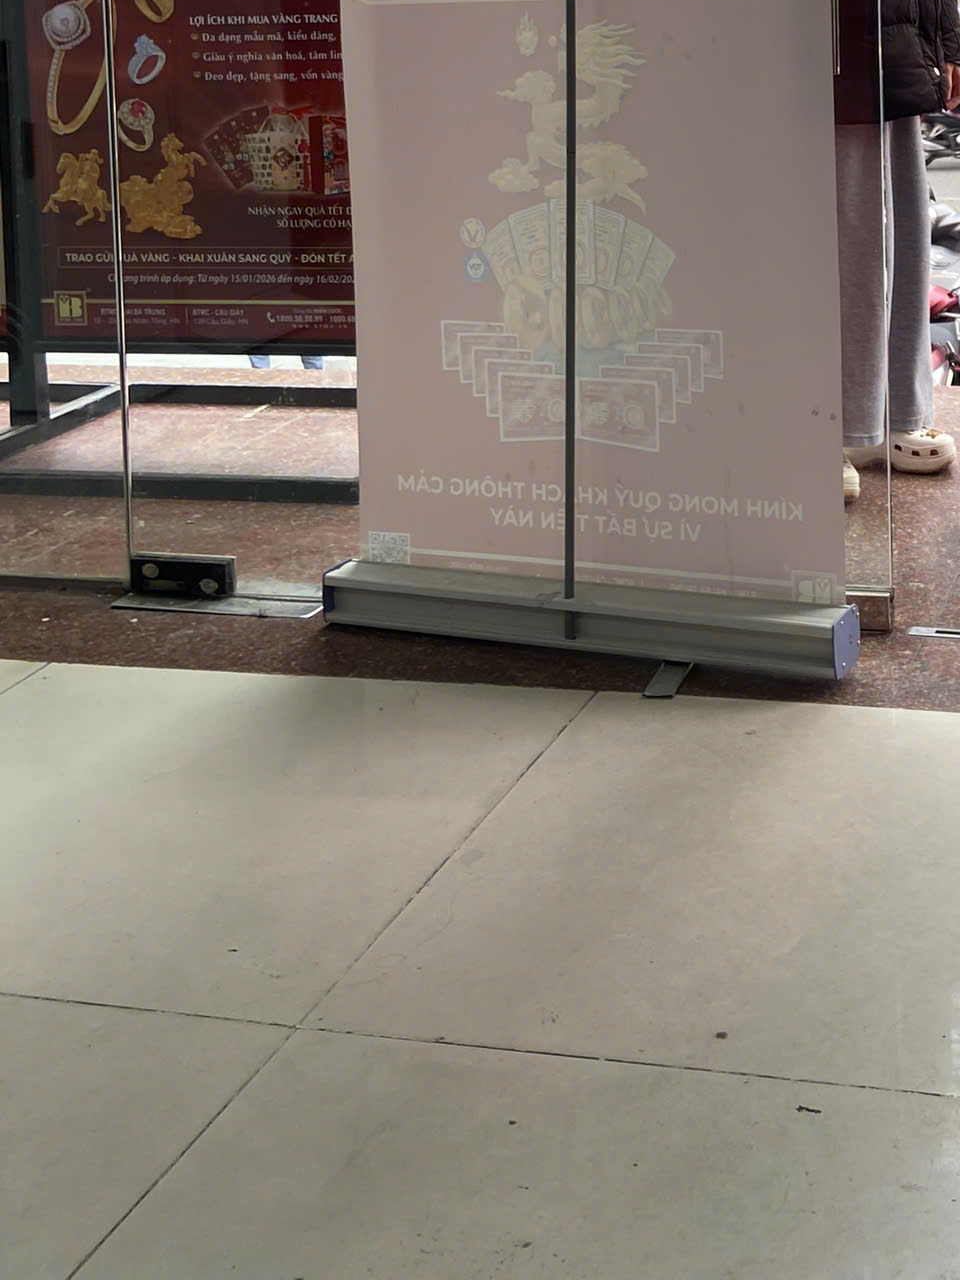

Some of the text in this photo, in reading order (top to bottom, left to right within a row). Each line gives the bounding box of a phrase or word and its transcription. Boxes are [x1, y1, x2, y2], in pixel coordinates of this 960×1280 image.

[189, 12, 338, 27] LỢI ÍCH KHI MUA VÀNG TRANG
[202, 32, 215, 42] Đa
[218, 32, 242, 44] dạng
[287, 28, 308, 41] kiểu
[203, 50, 225, 61] Giàu
[228, 51, 234, 63] ý
[309, 51, 327, 60] tâm
[330, 50, 343, 60] lin
[204, 72, 223, 81] Đeo
[301, 69, 318, 80] vốn
[248, 205, 276, 217] NHẬN
[277, 206, 303, 216] NGAY
[305, 205, 326, 217] QUÀ
[328, 203, 345, 216] TẾT
[276, 217, 353, 231] SỐ LƯỢNG CÓ HẠ
[65, 253, 93, 263] TRAO
[122, 251, 139, 263] UÀ
[140, 251, 170, 263] VÀNG
[178, 253, 204, 263] KHAI
[207, 251, 236, 263] XUÂN
[238, 253, 267, 263] SANG
[301, 251, 326, 263] ĐÓN
[328, 250, 347, 263] TẾT
[208, 274, 229, 285] ngày
[231, 273, 276, 284] 15/01/2026
[293, 274, 315, 286] ngày
[316, 274, 355, 284] 16/02/20
